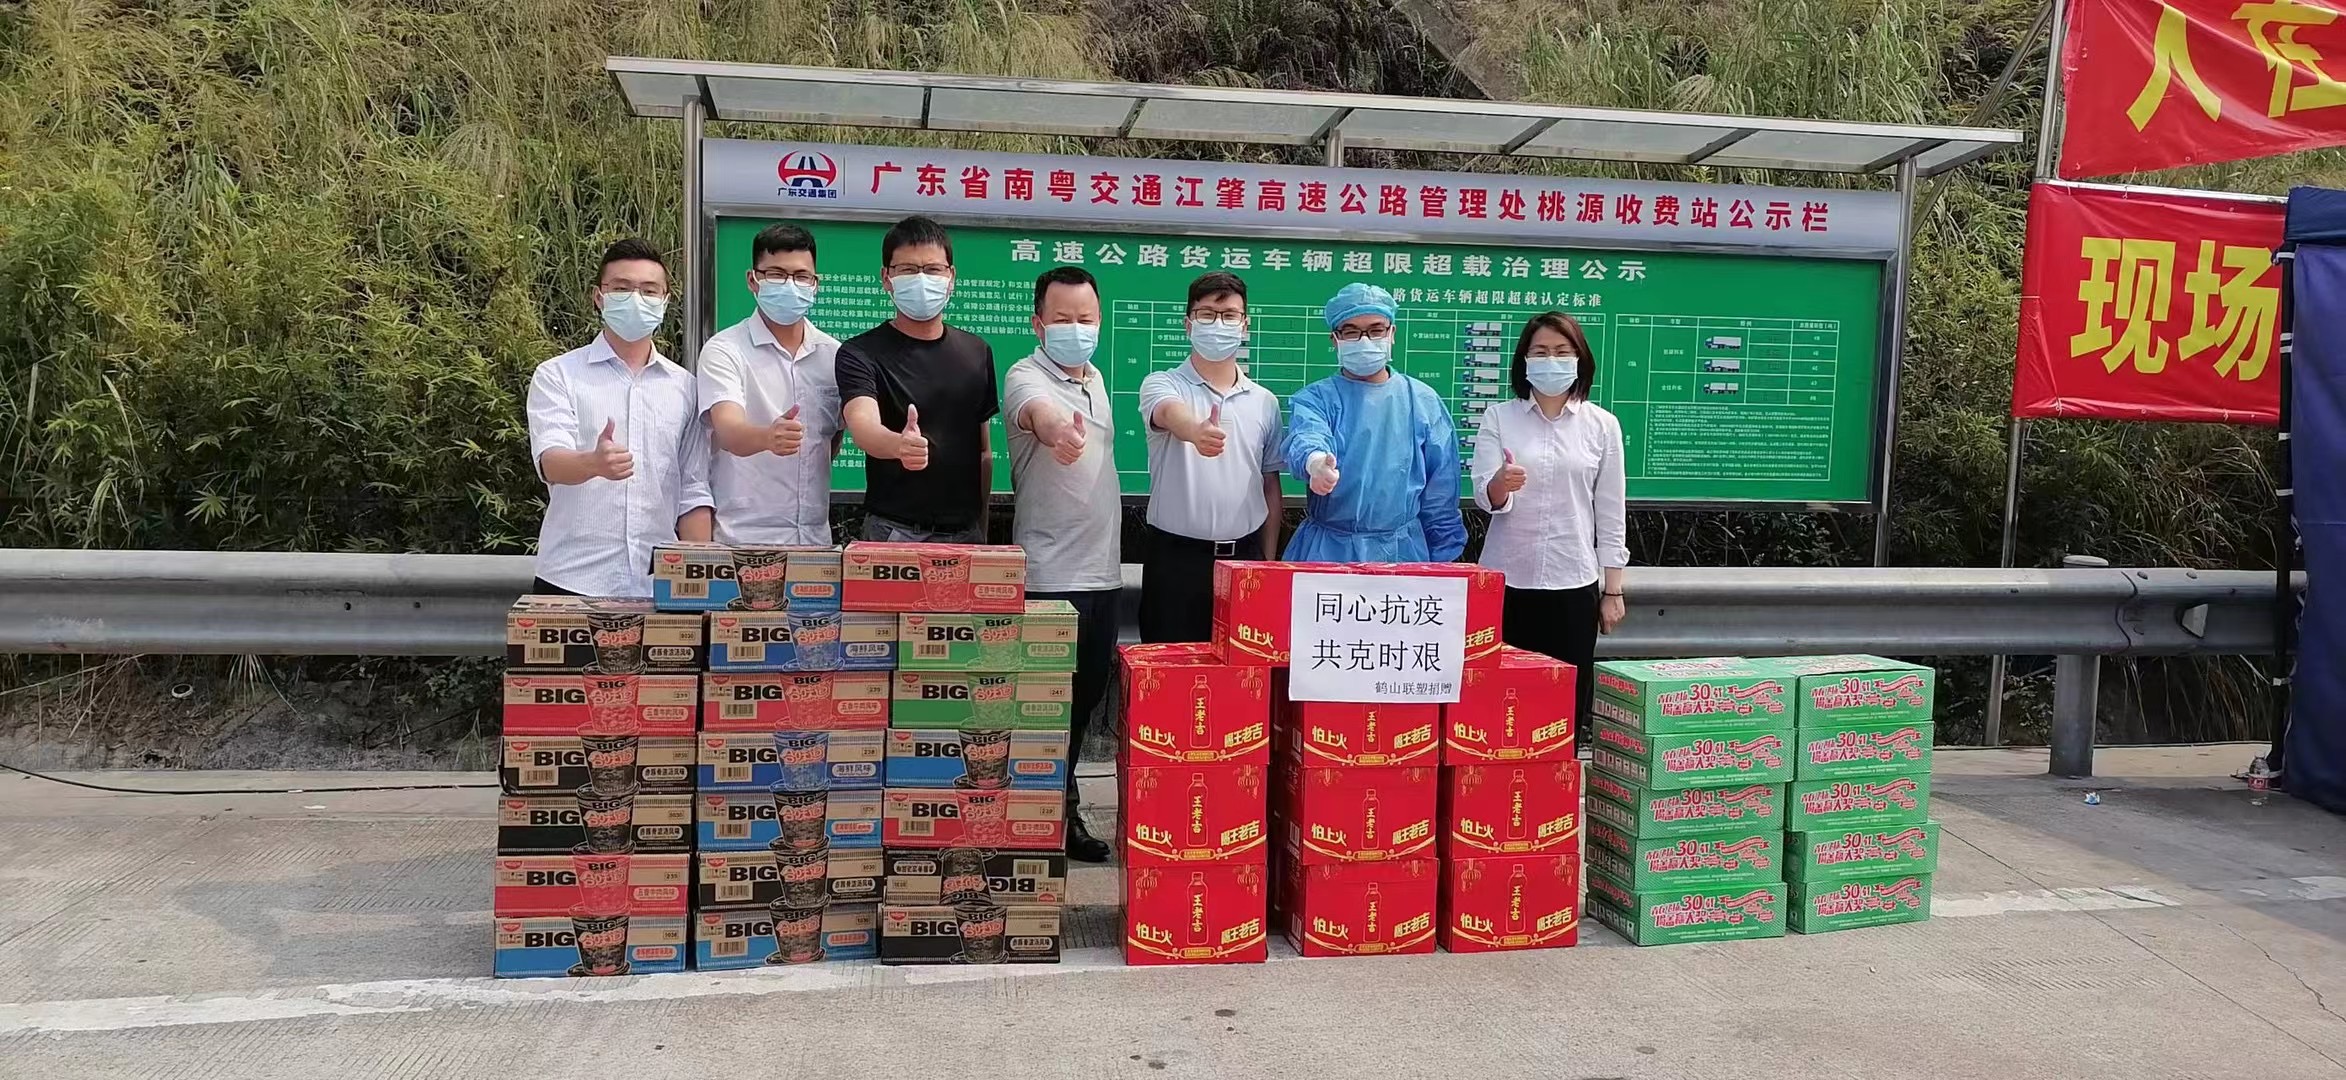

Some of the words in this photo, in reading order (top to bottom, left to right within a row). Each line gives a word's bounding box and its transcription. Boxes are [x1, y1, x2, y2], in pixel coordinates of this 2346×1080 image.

[778, 188, 837, 199] 广东交通集团
[871, 162, 1829, 232] 广东省南粤交通江肇高速公路管理处桃源收费站公示栏
[1010, 238, 1648, 282] 高速公路货运车辆超限超载治理公示
[1386, 287, 1602, 308] 路货运车辆超限超载认定标准
[2070, 236, 2281, 381] 现场
[746, 556, 774, 564] BIG
[686, 564, 735, 579] BIG
[873, 566, 920, 580] BIG
[1315, 592, 1443, 626] 同心抗疫
[802, 618, 830, 626] BIG
[985, 618, 1012, 626] BIG
[540, 629, 591, 643] BIG
[742, 628, 790, 641] BIG
[928, 627, 974, 641] BIG
[1238, 623, 1274, 649] 怕上火
[850, 644, 885, 653] 海鲜风味
[1311, 639, 1442, 672] 共克时艰
[794, 676, 821, 684] BIG
[980, 677, 1005, 685] BIG
[1375, 681, 1452, 696] 鹤山联塑捐赠
[535, 689, 585, 703] BIG
[734, 685, 782, 700] BIG
[922, 685, 968, 699] BIG
[1195, 697, 1206, 735] 王老吉
[1505, 706, 1515, 737] 王老吉
[1139, 724, 1176, 749] 怕上火
[1224, 722, 1263, 748] 喝王老吉
[1312, 725, 1348, 750] 怕上火
[1366, 711, 1377, 743] 王老吉
[1394, 724, 1432, 749] 喝王老吉
[1454, 722, 1488, 745] 怕上火
[1532, 718, 1568, 744] 喝王老吉
[789, 739, 816, 747] BIG
[973, 735, 998, 743] BIG
[534, 752, 585, 766] BIG
[729, 749, 777, 762] BIG
[915, 743, 961, 757] BIG
[836, 765, 872, 773] 海鲜风味
[531, 810, 580, 824] BIG
[729, 806, 776, 820] BIG
[912, 803, 958, 817] BIG
[1192, 795, 1203, 834] 王老吉
[1512, 791, 1523, 827] 王老吉
[1221, 820, 1260, 846] 喝王老吉
[1365, 807, 1376, 839] 王老吉
[1393, 819, 1429, 845] 喝王老吉
[1461, 818, 1494, 840] 怕上火
[1538, 813, 1574, 838] 喝王老吉
[1136, 823, 1173, 847] 怕上火
[1312, 823, 1347, 846] 怕上火
[589, 862, 616, 870] BIG
[789, 856, 815, 864] BIG
[527, 871, 576, 885] BIG
[730, 867, 777, 881] BIG
[990, 878, 1035, 892] BIG
[1192, 893, 1203, 933] 王老吉
[1510, 885, 1521, 921] 王老吉
[1367, 901, 1377, 933] 王老吉
[1394, 912, 1430, 938] 喝王老吉
[1461, 913, 1494, 934] 怕上火
[1537, 907, 1573, 931] 喝王老吉
[726, 922, 772, 937] BIG
[911, 921, 957, 935] BIG
[1136, 922, 1173, 946] 怕上火
[1221, 918, 1260, 944] 喝王老吉
[1313, 916, 1349, 940] 怕上火
[526, 932, 575, 946] BIG
